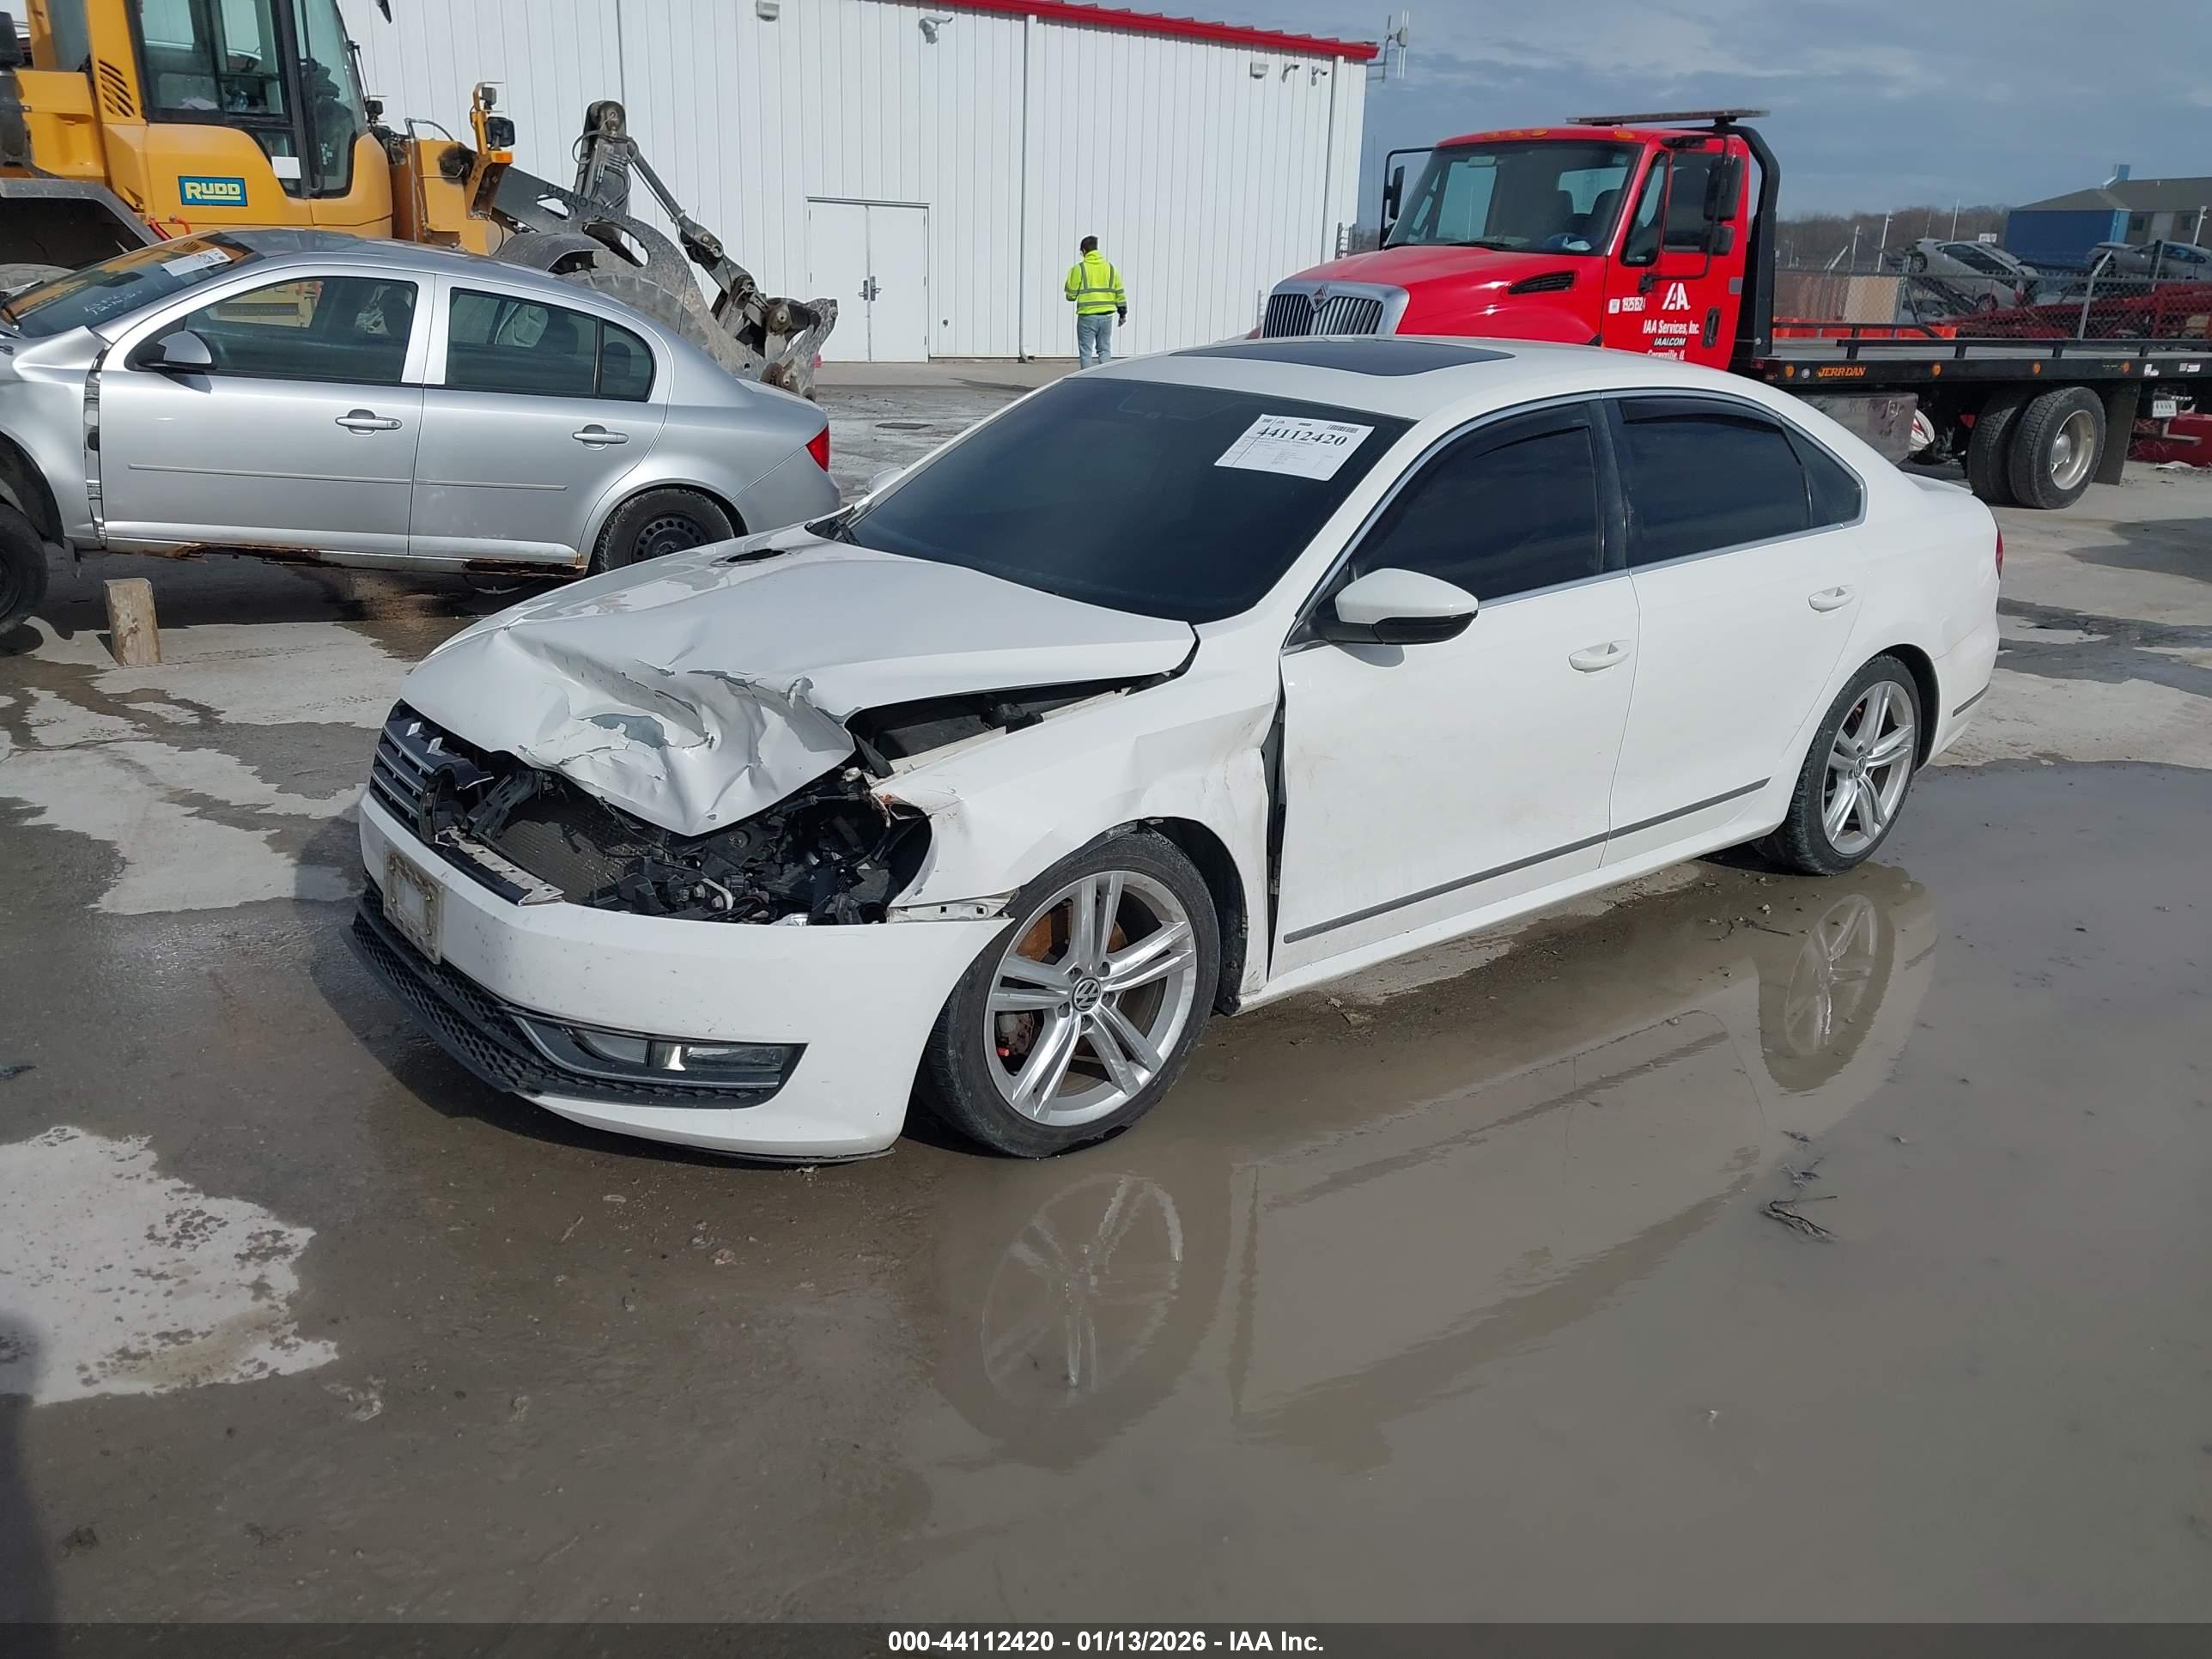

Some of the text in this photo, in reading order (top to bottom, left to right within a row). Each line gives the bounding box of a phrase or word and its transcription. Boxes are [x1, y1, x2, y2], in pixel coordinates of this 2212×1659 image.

[185, 181, 241, 200] RUDD
[1643, 319, 1657, 334] IAA
[1657, 319, 1688, 336] Services,
[1256, 427, 1348, 447] 44112420
